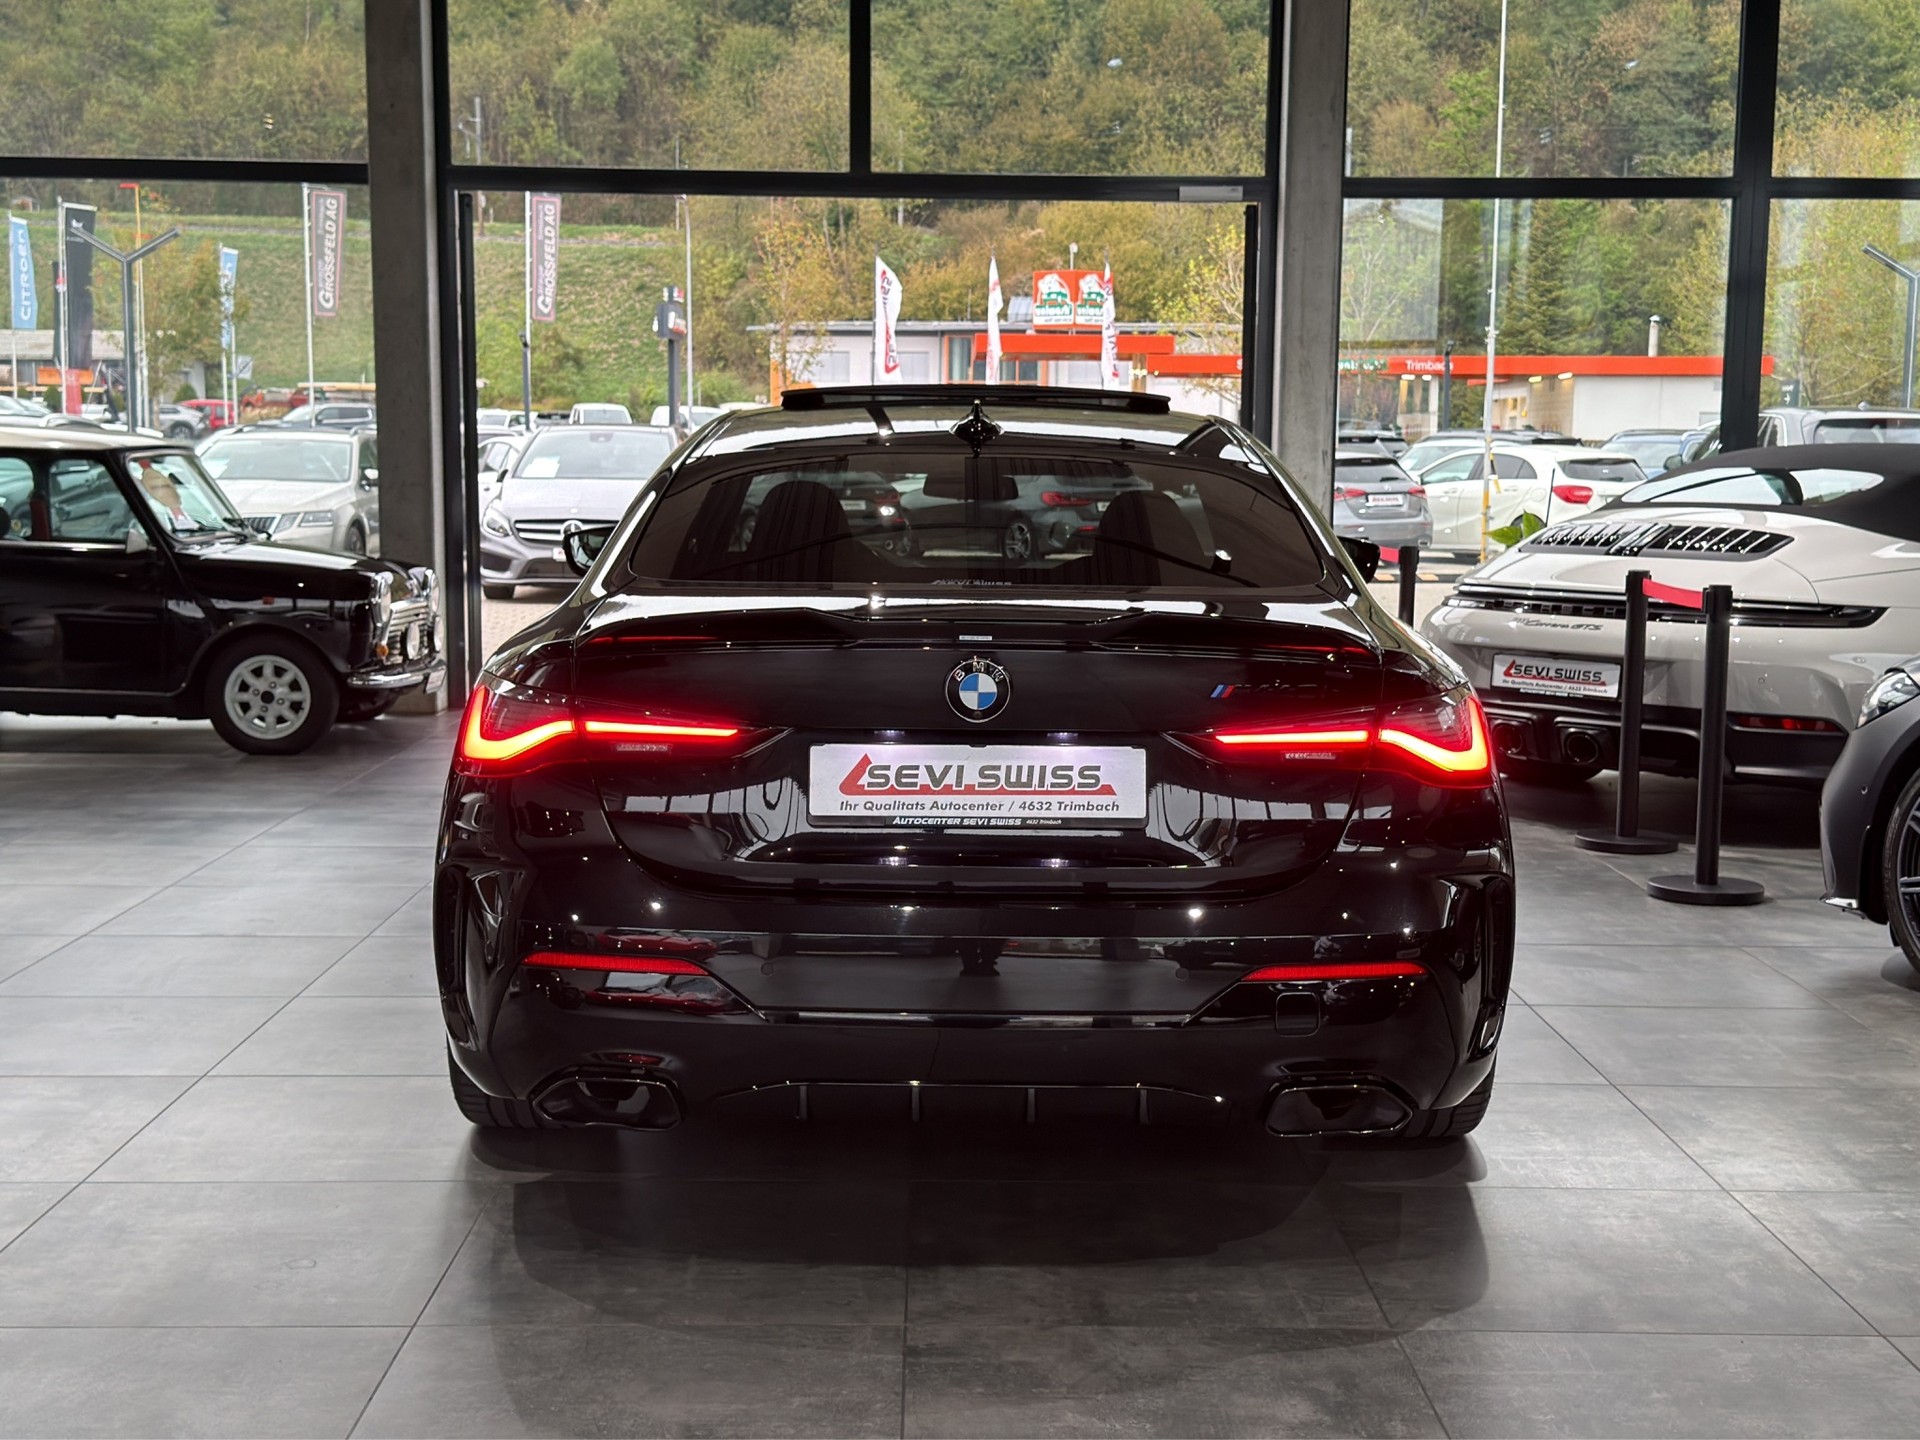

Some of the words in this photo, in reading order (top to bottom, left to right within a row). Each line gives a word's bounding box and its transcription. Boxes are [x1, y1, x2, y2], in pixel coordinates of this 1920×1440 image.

[954, 661, 1004, 682] BMW
[1513, 664, 1551, 677] SEVI
[1554, 668, 1602, 682] SWISS
[866, 764, 965, 789] SEVI
[977, 764, 1101, 789] SWISS
[839, 800, 859, 811] Ihr
[863, 800, 926, 812] Qualitats
[929, 800, 1004, 812] Autocenter
[1018, 801, 1053, 812] 4632
[1057, 801, 1120, 812] Trimbach
[962, 817, 988, 826] SEVI
[989, 818, 1022, 826] SWISS
